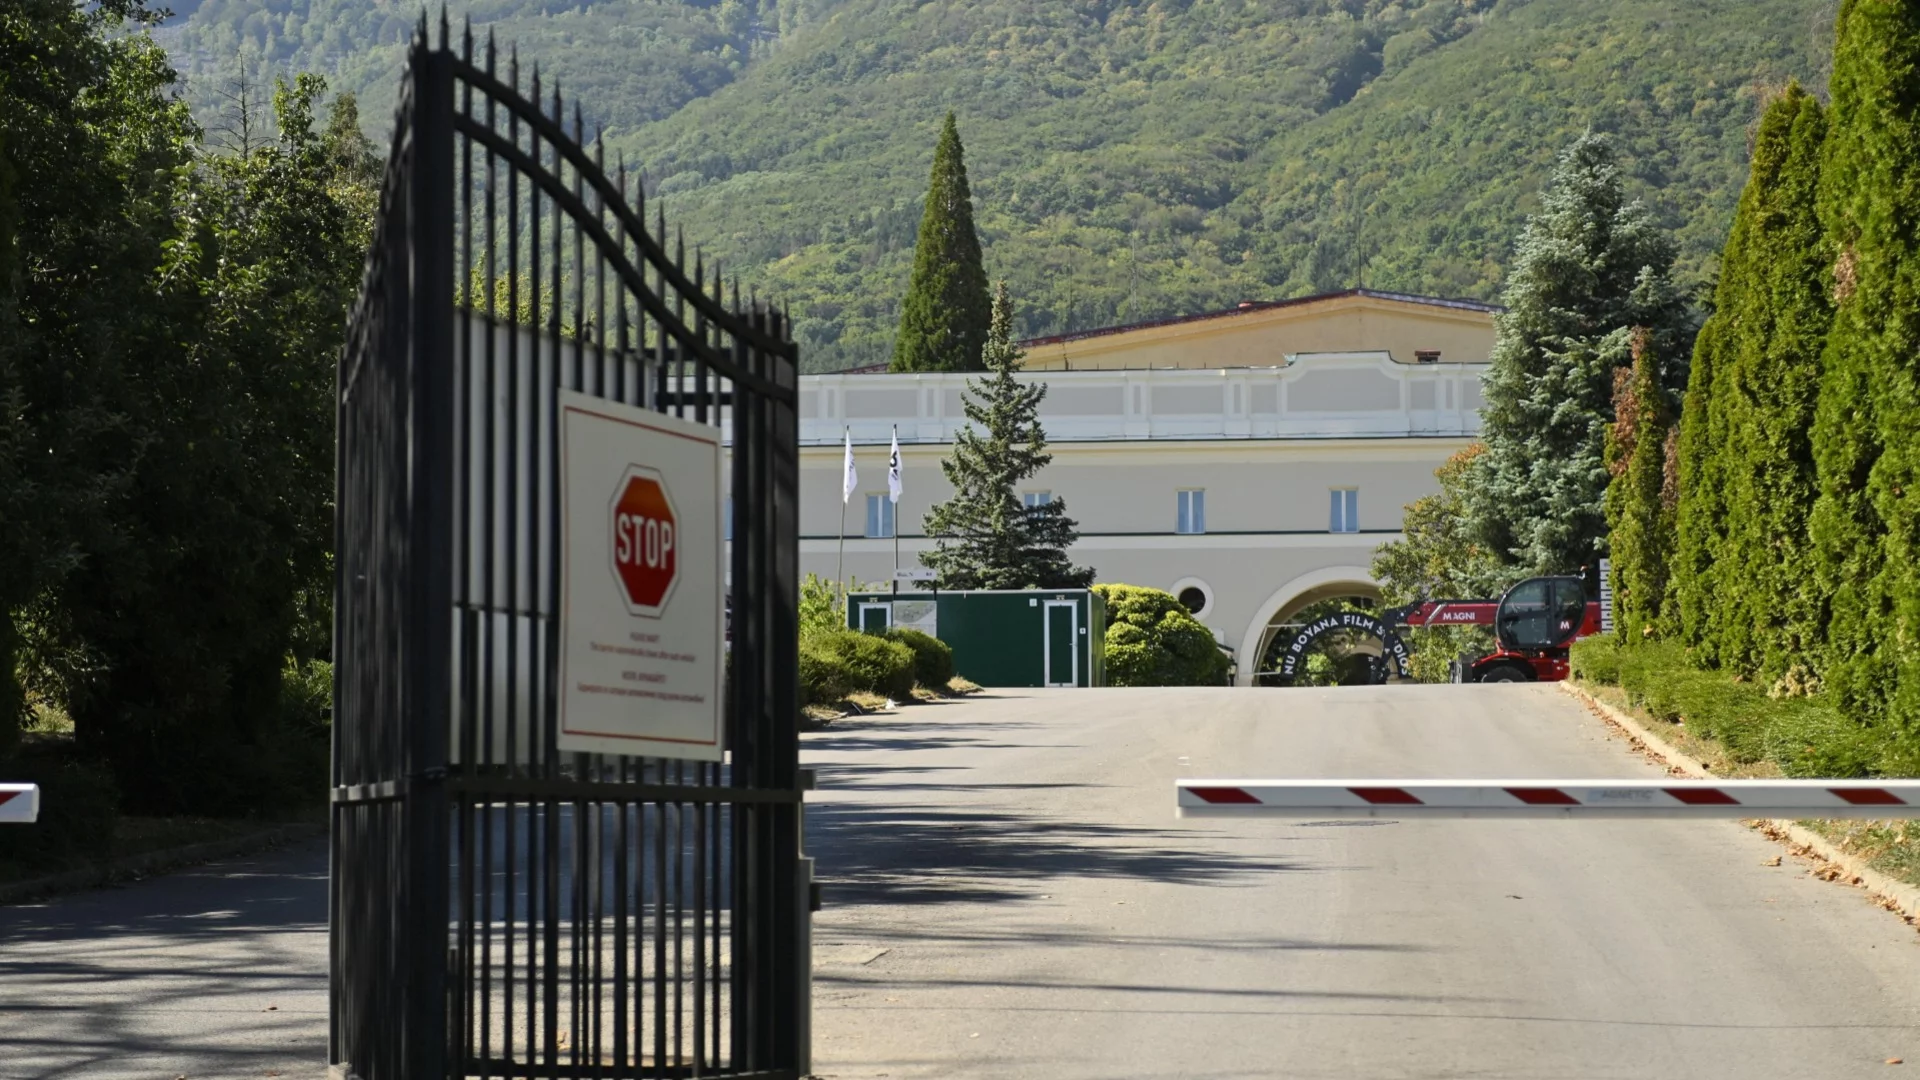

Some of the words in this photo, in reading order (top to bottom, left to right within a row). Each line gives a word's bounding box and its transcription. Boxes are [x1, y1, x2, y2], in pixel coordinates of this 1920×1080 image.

[618, 512, 673, 570] STOP
[1443, 612, 1475, 621] MAGNI
[1560, 621, 1570, 629] M
[1285, 655, 1296, 674] NU
[1292, 617, 1339, 652] BOYANA
[1343, 615, 1374, 629] FILM
[1376, 625, 1410, 675] SDIOS
